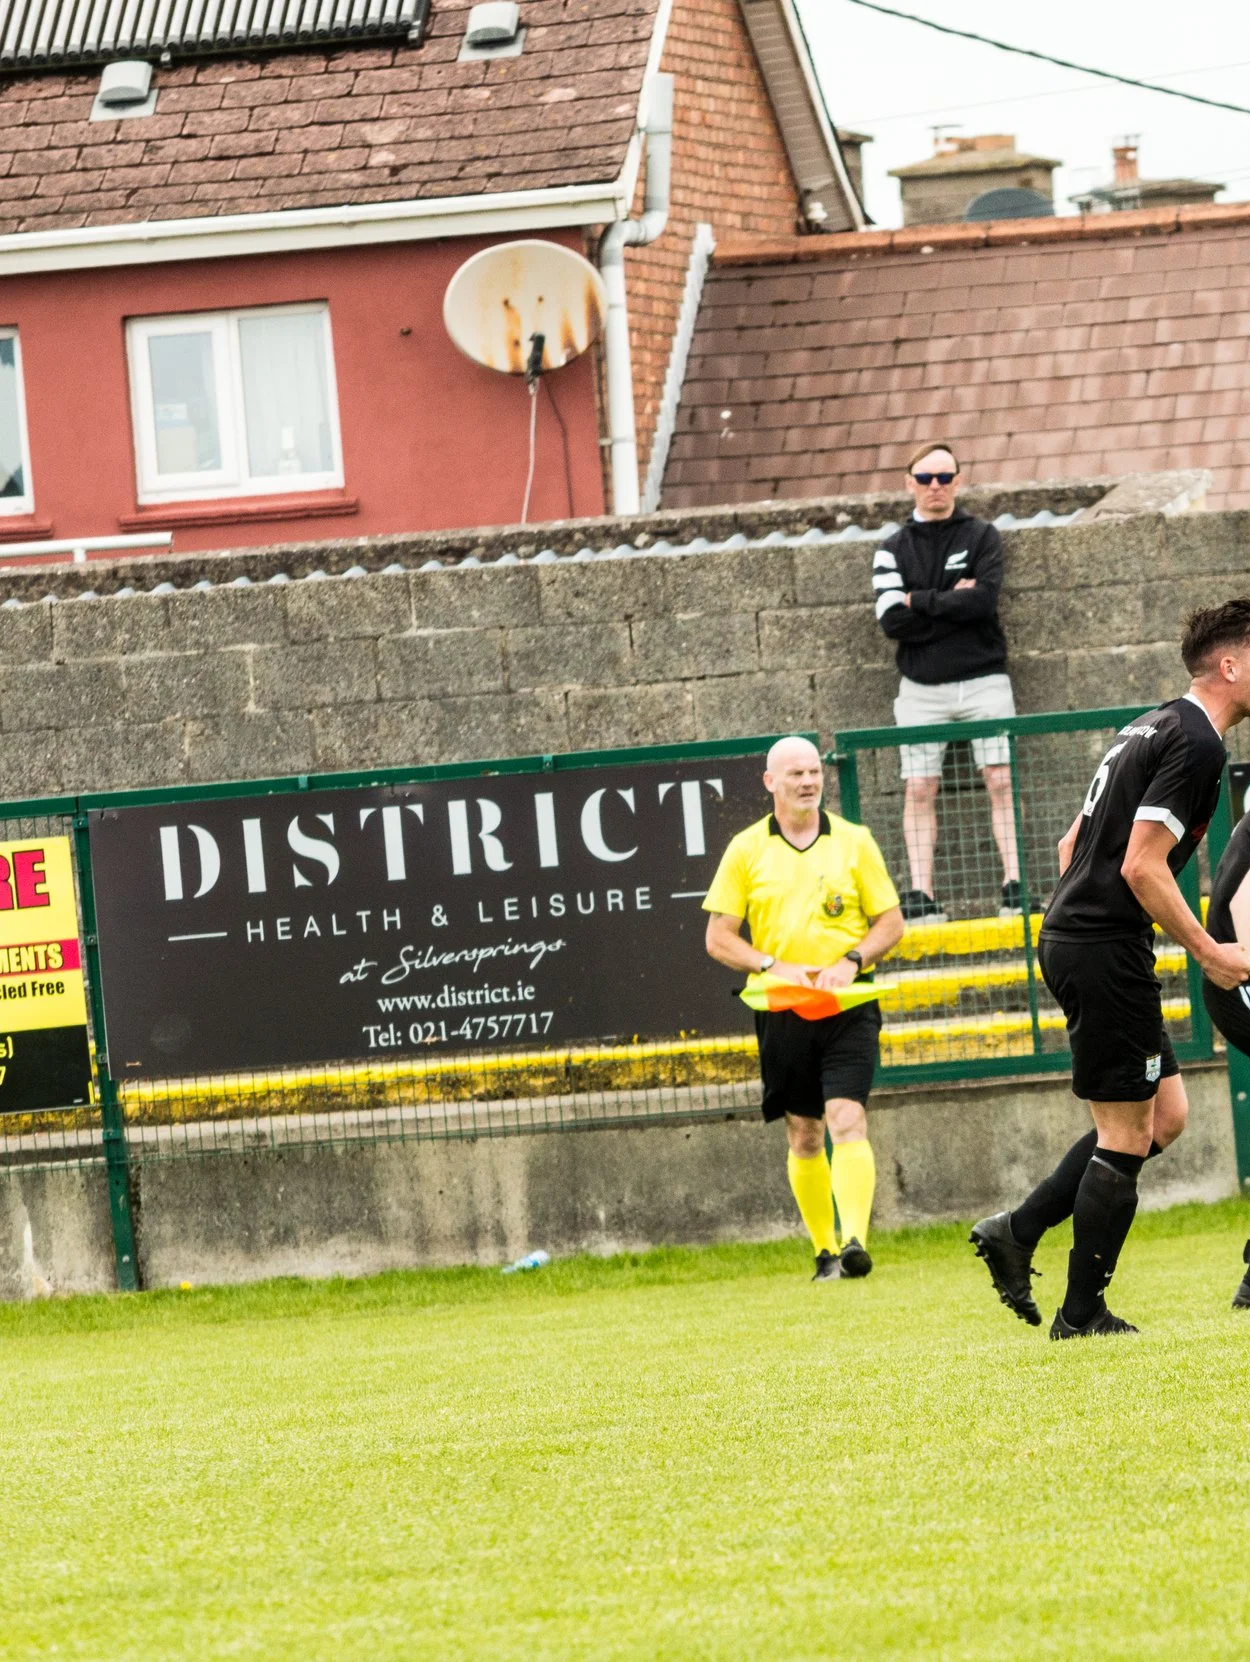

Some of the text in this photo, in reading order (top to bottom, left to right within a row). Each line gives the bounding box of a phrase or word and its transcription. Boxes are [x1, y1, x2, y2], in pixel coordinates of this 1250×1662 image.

[159, 778, 725, 902] DISTRICT
[246, 886, 653, 943] HEALTH & LEISURE
[339, 937, 567, 985] at Silversprings
[0, 980, 65, 1000] led Free
[377, 980, 536, 1013] www.district.ie
[362, 1011, 554, 1048] Tel: 021-4757717
